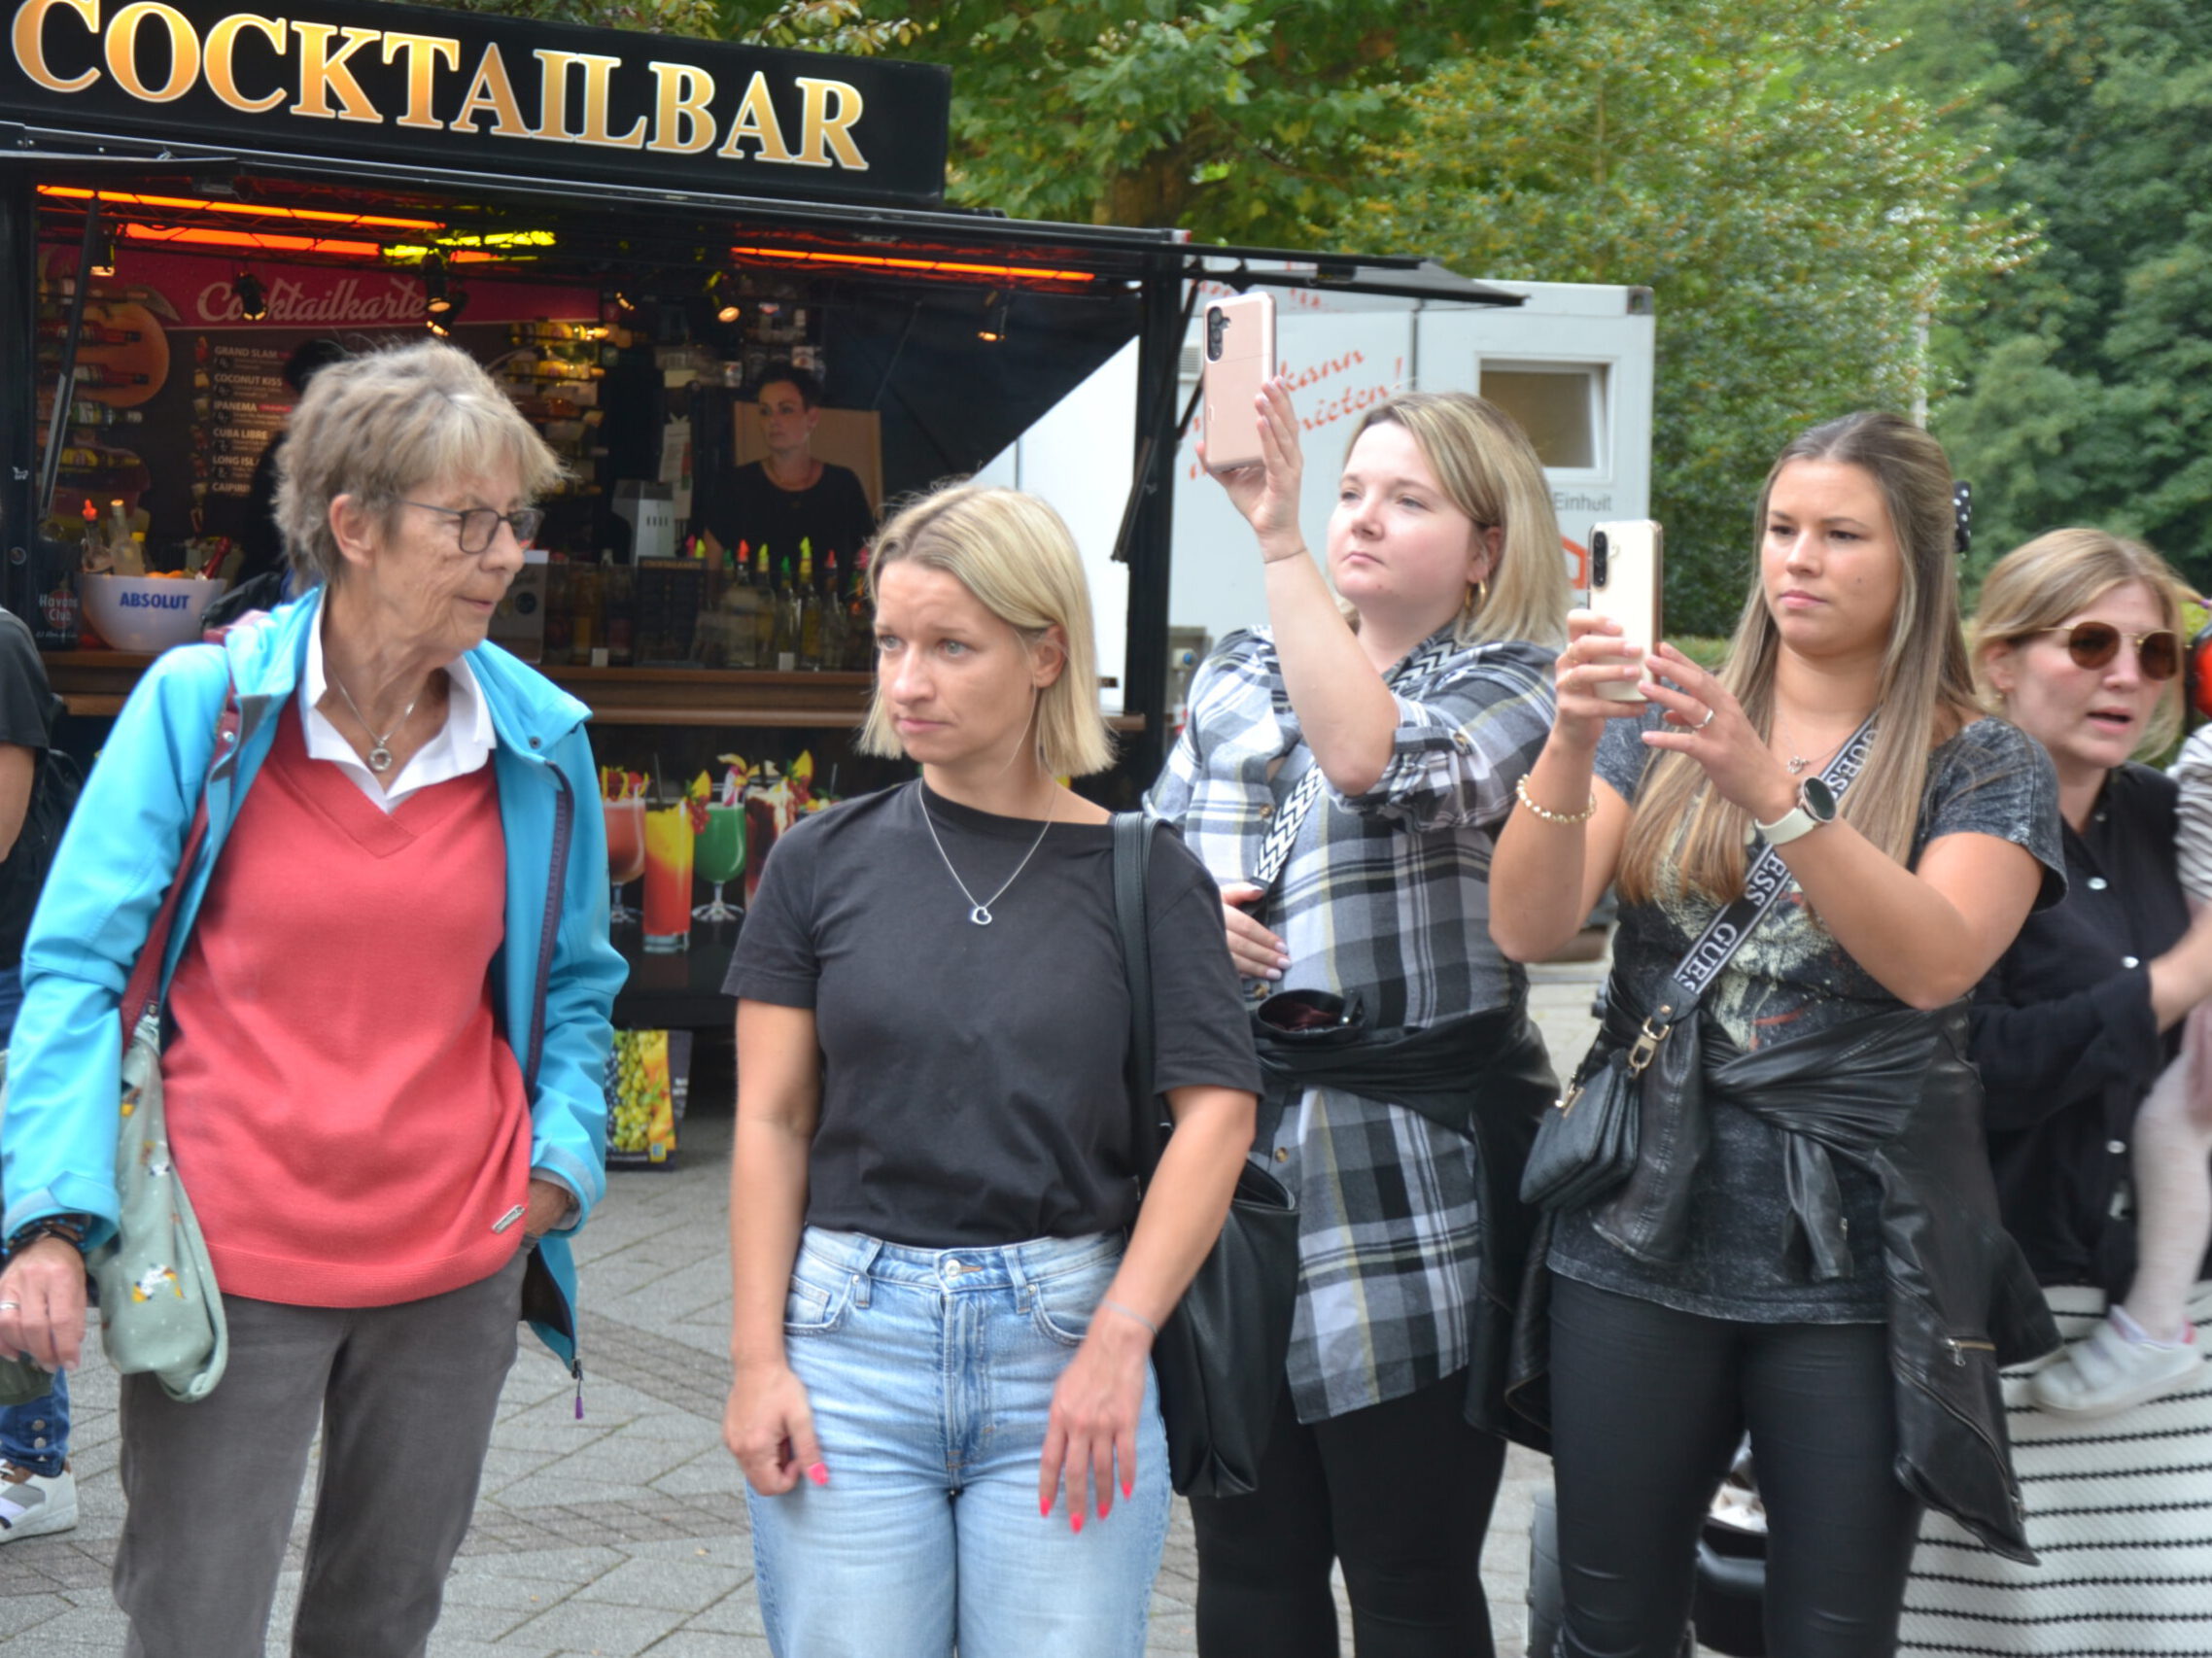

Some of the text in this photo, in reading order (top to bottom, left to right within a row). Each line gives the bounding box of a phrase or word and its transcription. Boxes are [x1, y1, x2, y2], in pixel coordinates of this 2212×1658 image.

[12, 0, 869, 171] COCKTAILBAR
[197, 277, 426, 322] Coktailkarte
[214, 345, 278, 359] GRAND SLAM
[1278, 349, 1365, 392] kann
[214, 373, 282, 387] COCONUT KISS
[214, 400, 258, 412] IPANEMA
[214, 428, 268, 440] CUBA LIBRE
[213, 456, 240, 466] LONG
[119, 592, 190, 609] ABSOLUT
[49, 608, 72, 622] Club
[1826, 729, 1878, 800] GUES
[1745, 851, 1788, 907] ESS
